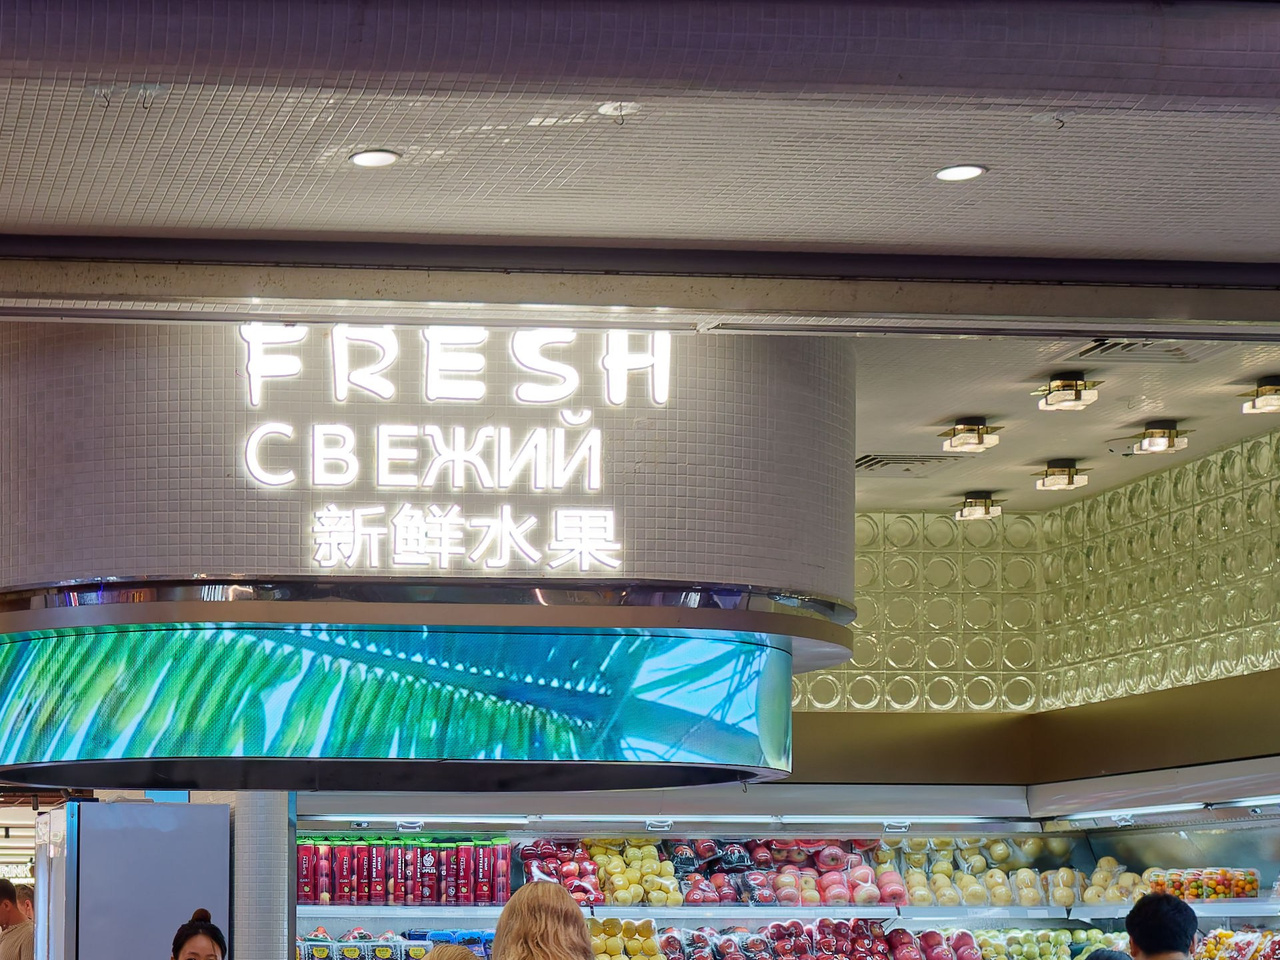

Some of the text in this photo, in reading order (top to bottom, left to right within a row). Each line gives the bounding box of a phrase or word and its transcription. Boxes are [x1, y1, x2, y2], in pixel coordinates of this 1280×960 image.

[239, 322, 671, 406] FRESH
[244, 408, 602, 491] СВЕЖИЙ
[312, 503, 622, 571] 新鲜水果
